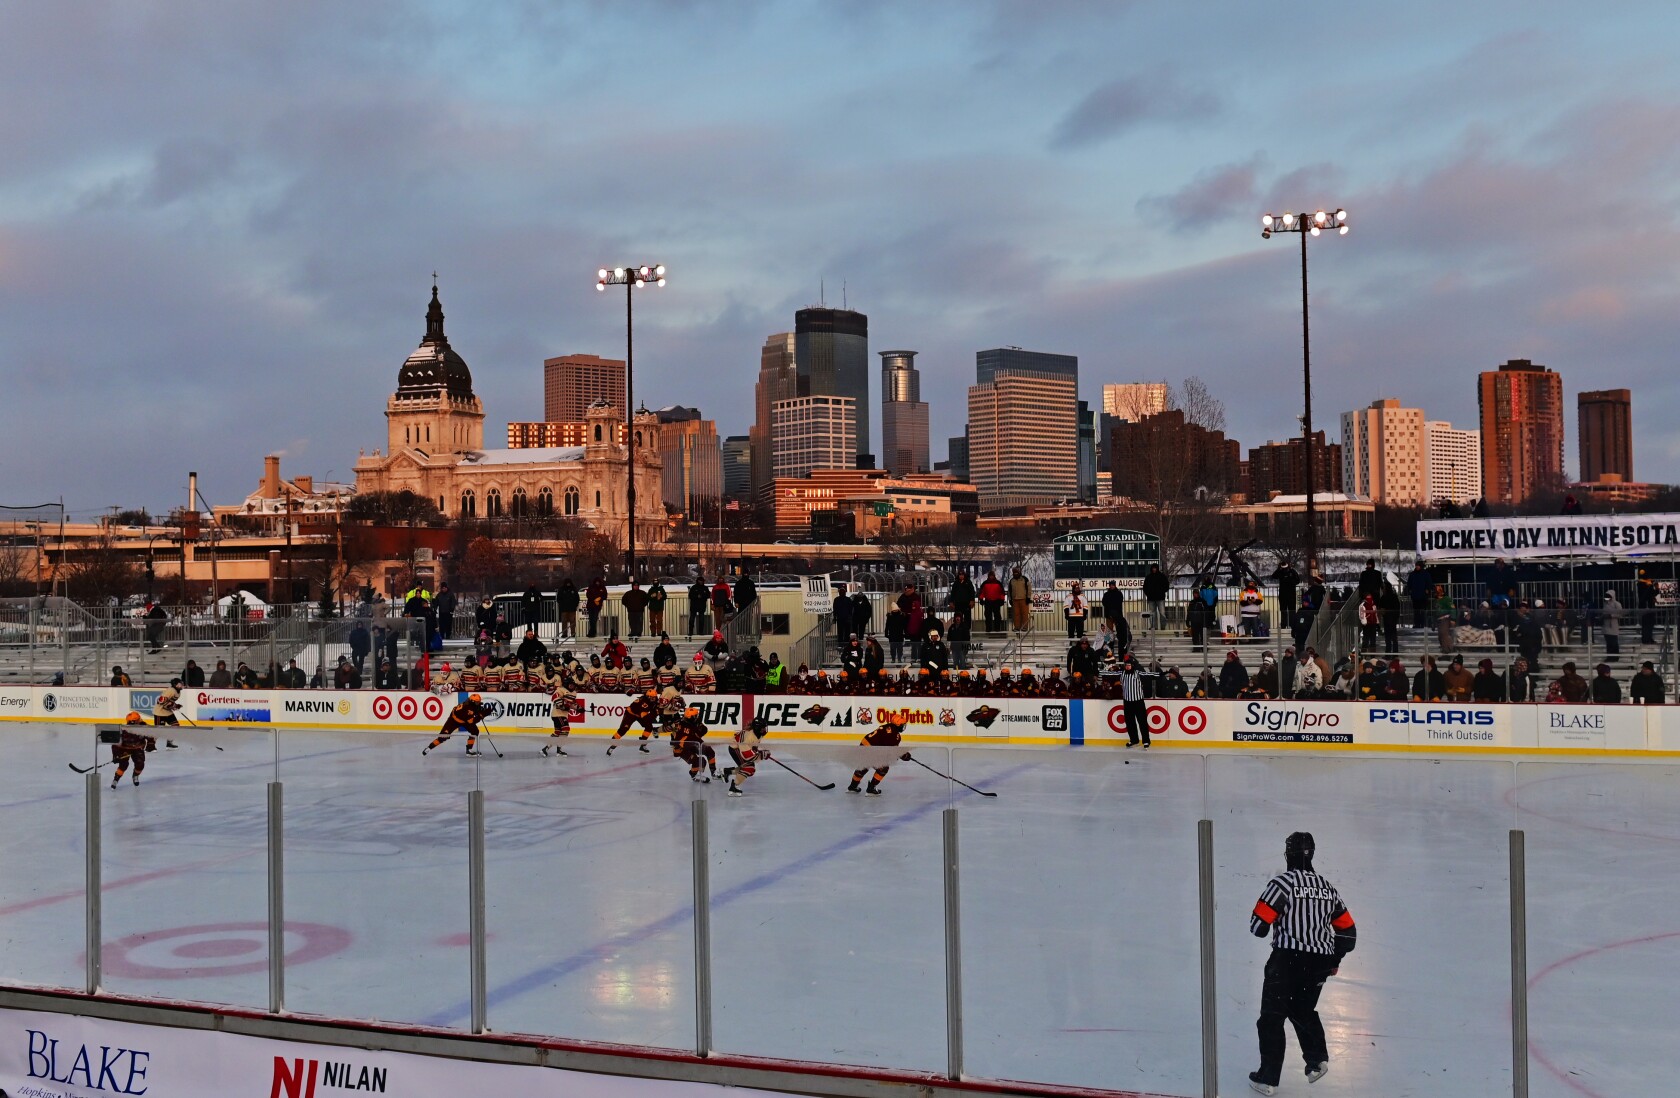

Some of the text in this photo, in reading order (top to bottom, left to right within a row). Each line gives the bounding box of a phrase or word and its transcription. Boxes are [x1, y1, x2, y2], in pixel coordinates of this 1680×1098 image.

[1421, 525, 1680, 550] HOCKEY DAY MINNESOTA
[1118, 579, 1144, 587] AUGGIE
[207, 694, 240, 704] Gertens
[285, 701, 334, 713] MARVIN
[506, 702, 551, 717] NORTH
[1045, 708, 1063, 716] FOX
[1001, 714, 1031, 722] STREAMING
[1369, 709, 1494, 725] POLARIS
[1550, 712, 1605, 728] BLAKE
[1046, 720, 1062, 728] GO
[1236, 733, 1348, 742] SignProWG.com 952.896.5276
[1427, 730, 1493, 740] Think Outside
[1293, 886, 1334, 900] CAPOCASA
[25, 1029, 150, 1096] BLAKE
[323, 1061, 388, 1093] NILAN
[17, 1086, 56, 1098] Hopkins
